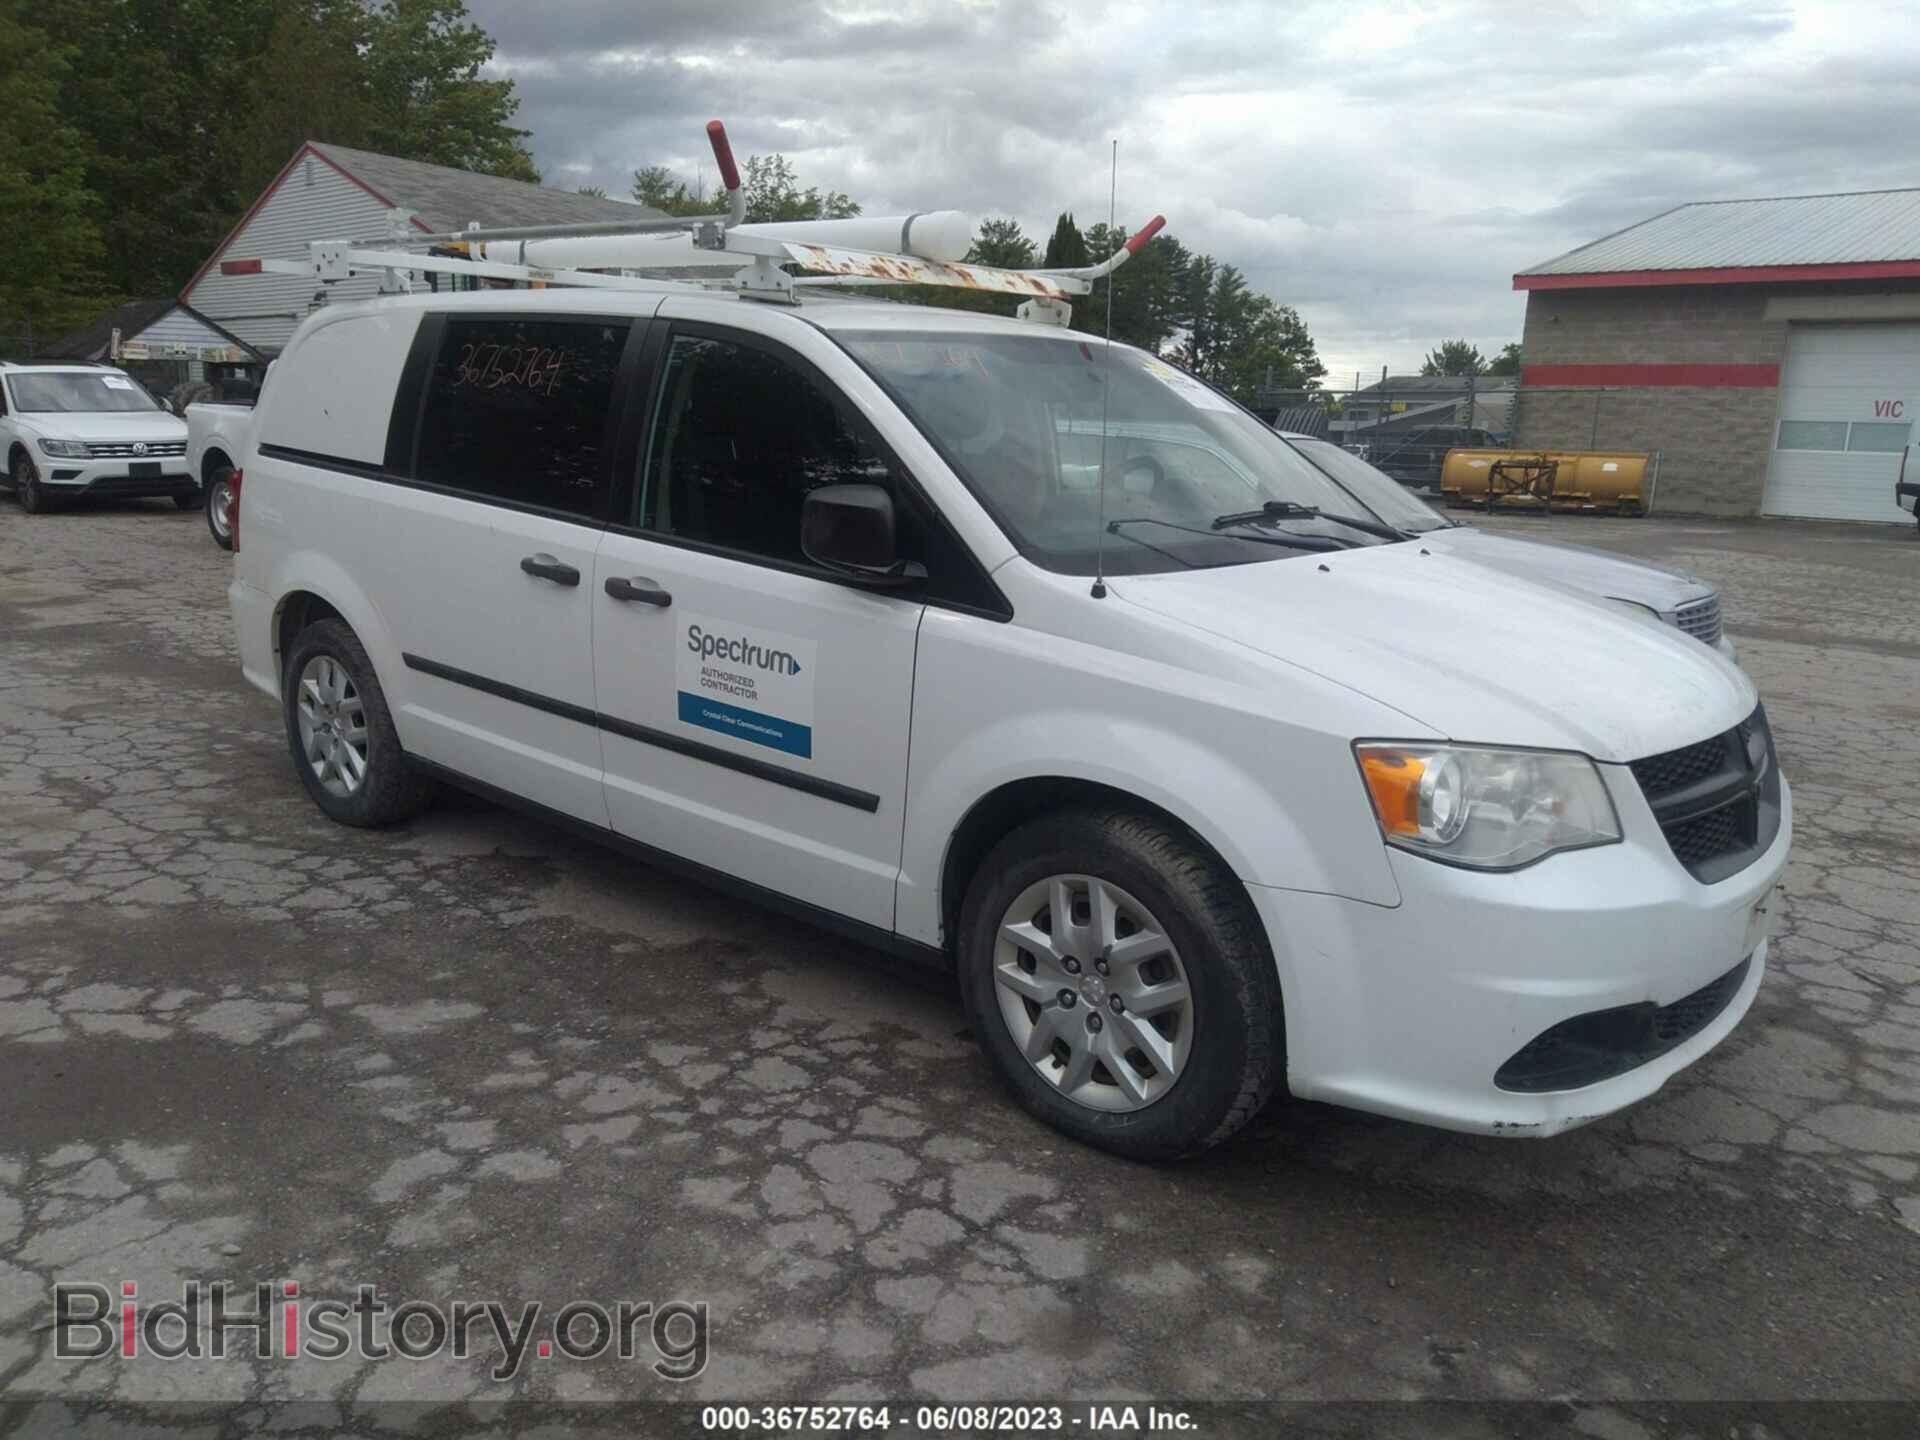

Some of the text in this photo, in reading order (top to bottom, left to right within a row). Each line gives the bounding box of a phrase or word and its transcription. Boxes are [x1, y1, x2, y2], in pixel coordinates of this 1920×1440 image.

[454, 344, 564, 396] 36752764
[1874, 400, 1904, 418] VIC
[688, 624, 795, 675] Spectrum
[701, 667, 754, 687] AUTHORIZED
[701, 678, 758, 700] CONTRACTOR
